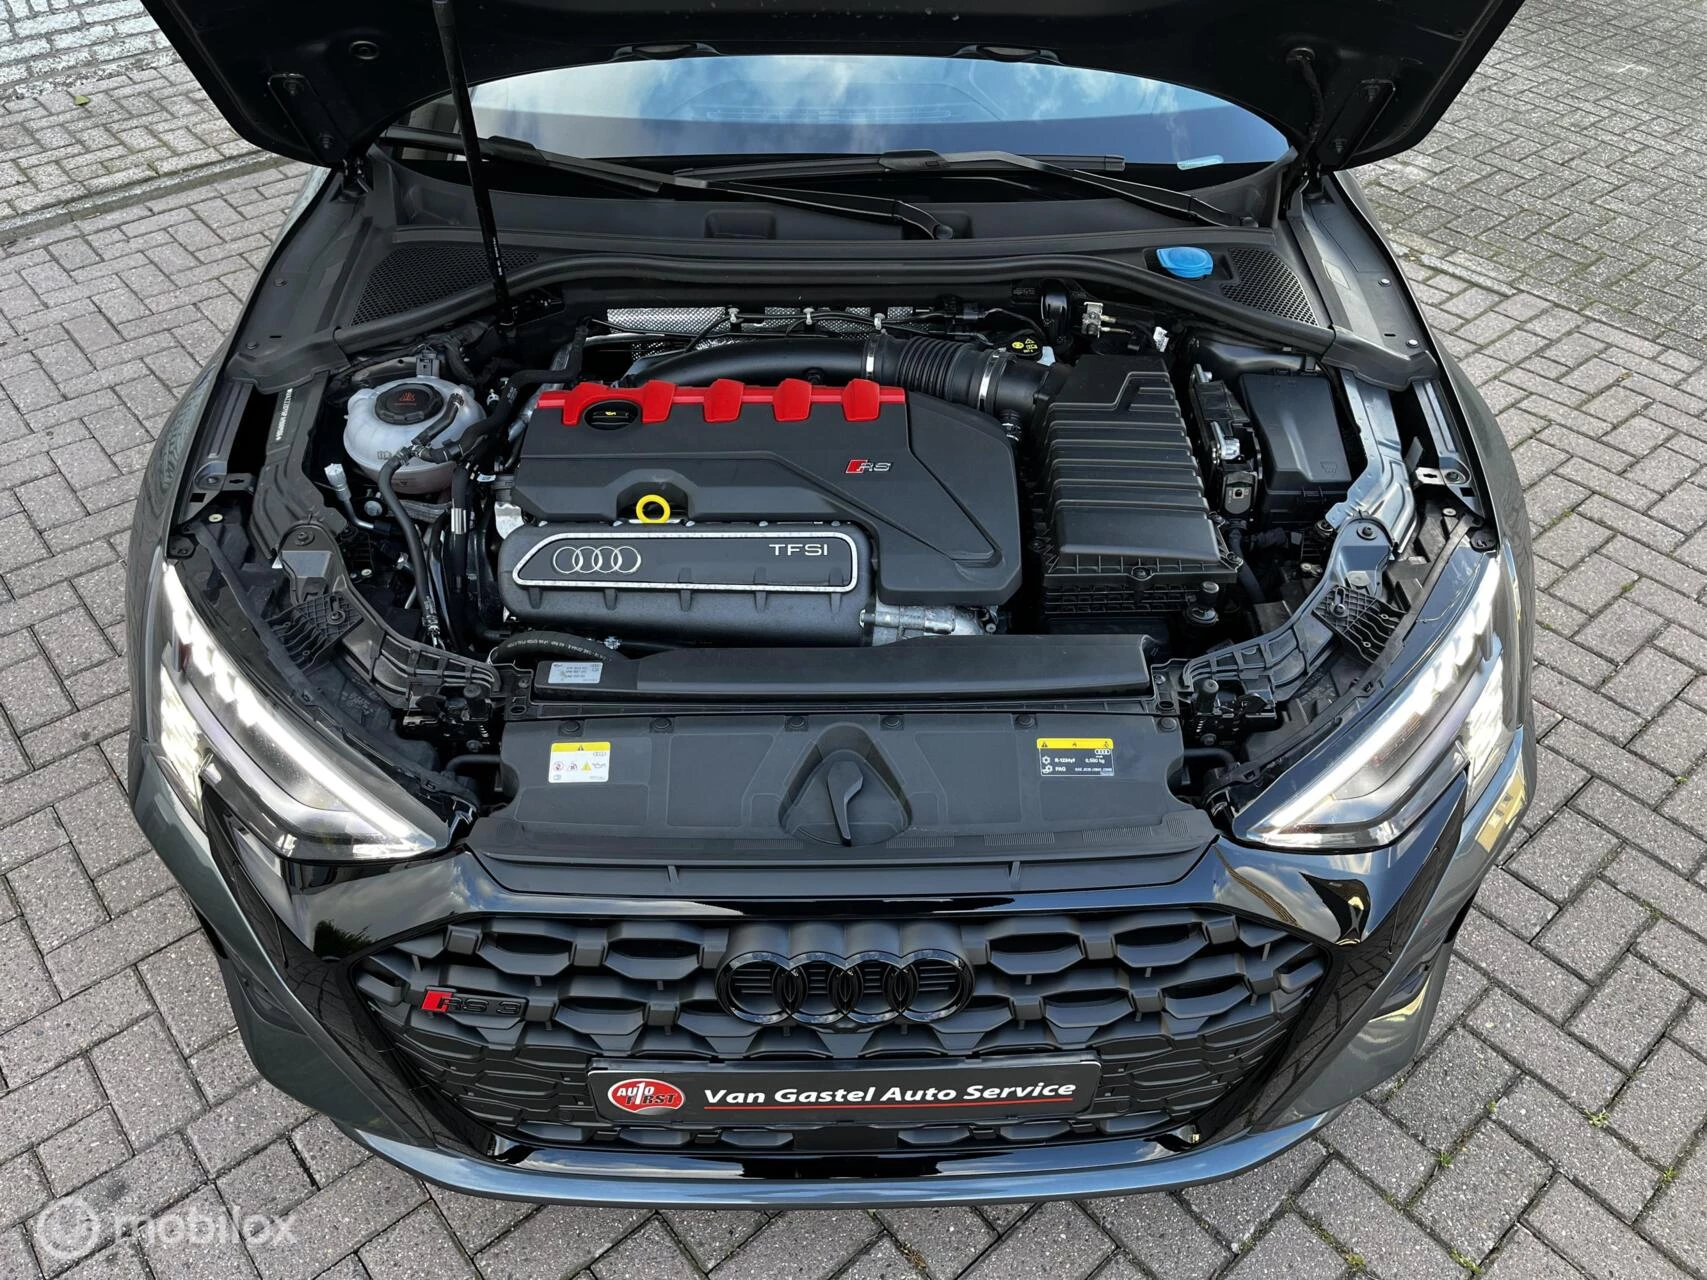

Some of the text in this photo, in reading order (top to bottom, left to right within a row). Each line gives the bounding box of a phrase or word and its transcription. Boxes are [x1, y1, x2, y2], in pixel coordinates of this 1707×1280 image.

[850, 460, 892, 473] RS
[768, 543, 828, 556] TFSI
[704, 1082, 1077, 1104] Van Gastel Auto Service
